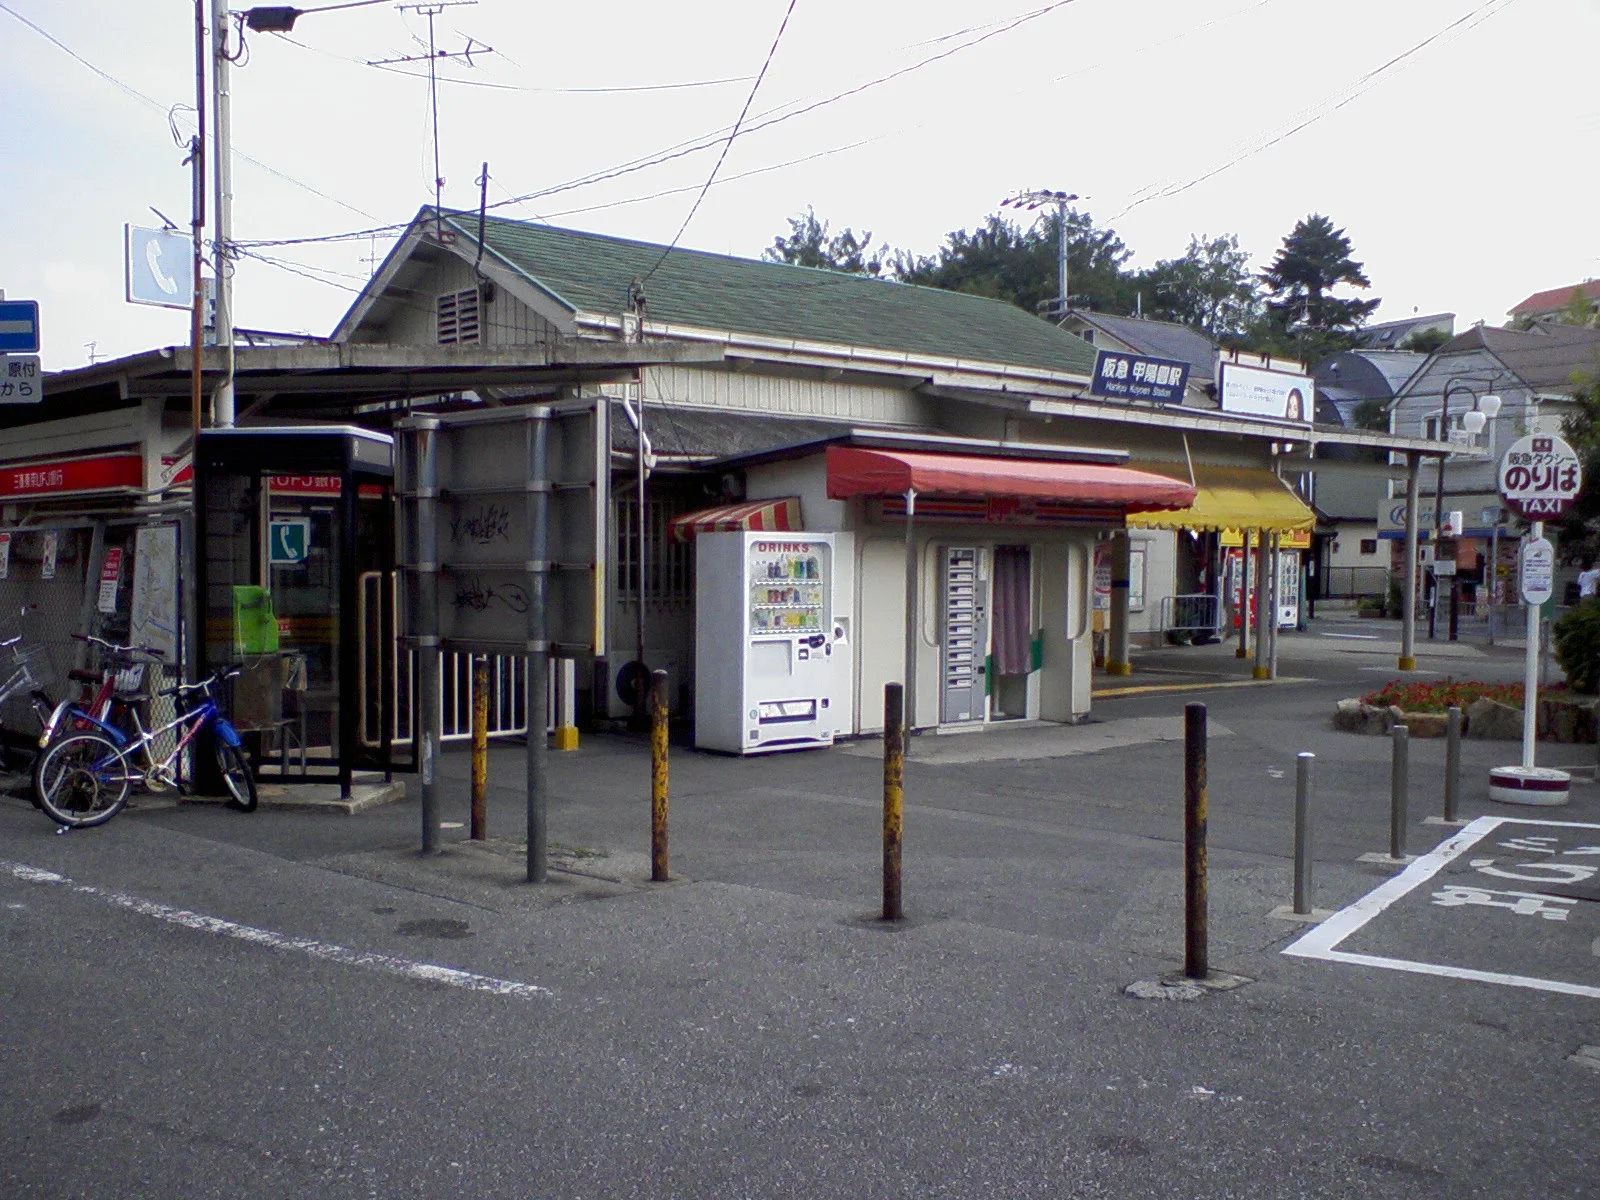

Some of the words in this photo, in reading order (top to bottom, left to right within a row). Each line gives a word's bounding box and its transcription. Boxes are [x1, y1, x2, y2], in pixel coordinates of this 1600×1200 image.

[1101, 358, 1129, 379] 阪急
[1508, 452, 1576, 466] 阪急タクシー
[1504, 463, 1578, 492] のりば
[1520, 499, 1562, 513] TAXI
[758, 542, 809, 553] DRINKS
